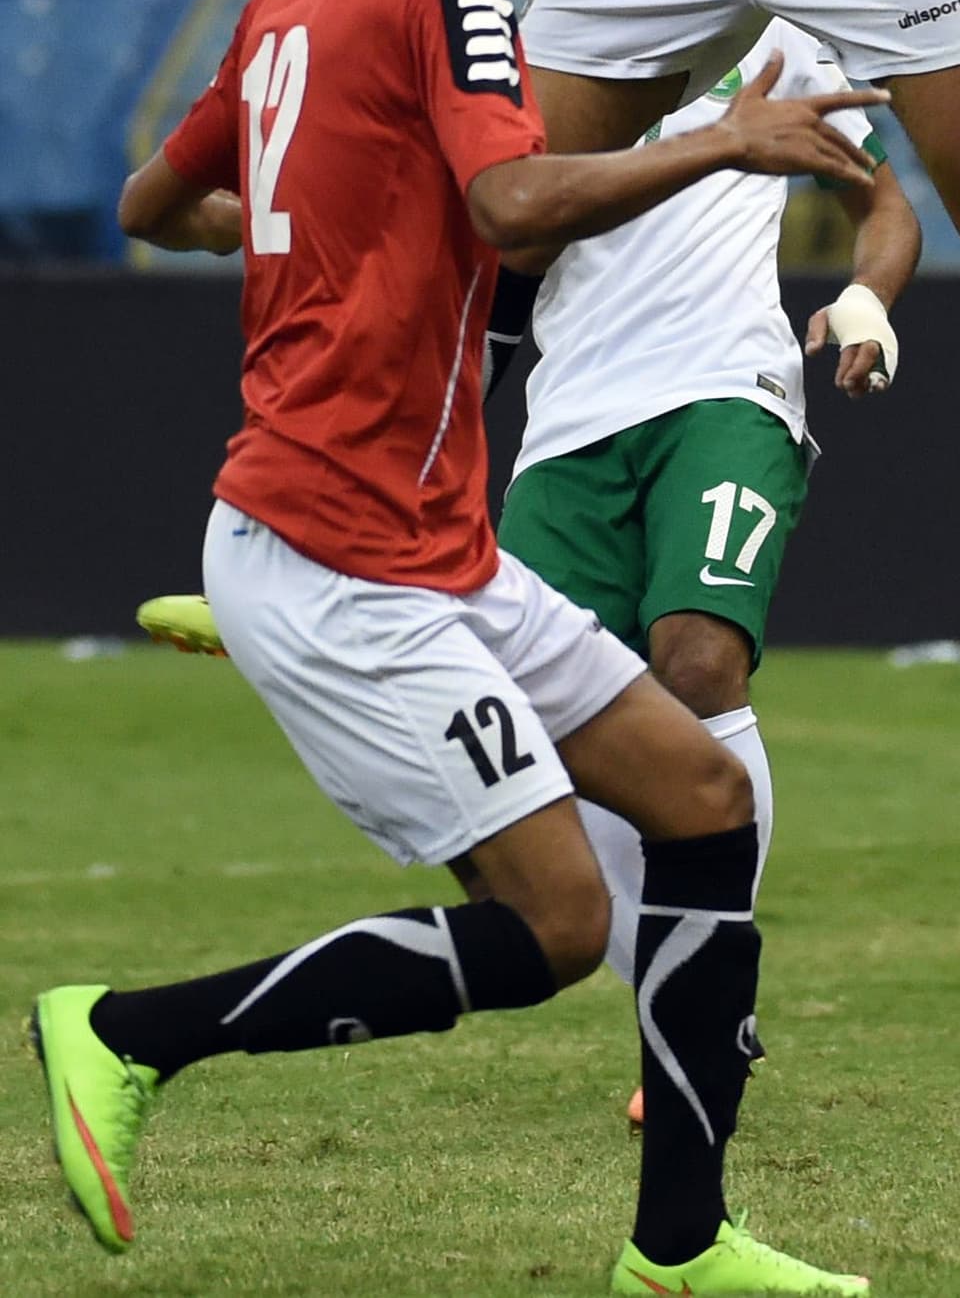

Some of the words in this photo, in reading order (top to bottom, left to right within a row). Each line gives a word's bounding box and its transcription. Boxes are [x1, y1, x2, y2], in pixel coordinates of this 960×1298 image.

[241, 25, 309, 254] 12
[701, 481, 776, 574] 17
[444, 696, 536, 789] 12
